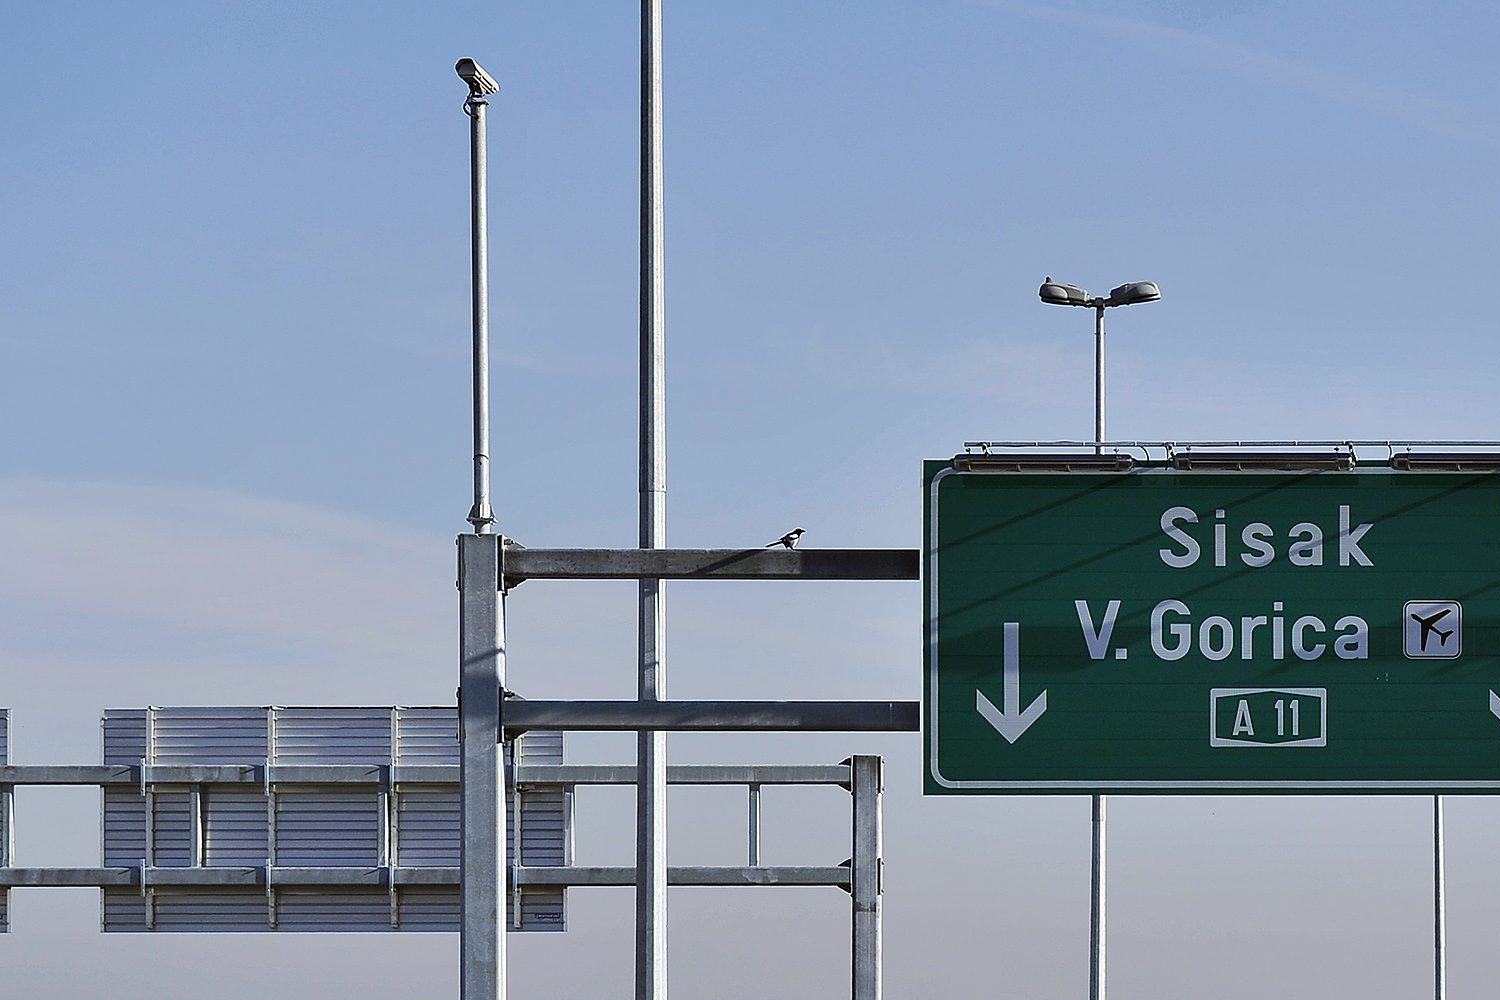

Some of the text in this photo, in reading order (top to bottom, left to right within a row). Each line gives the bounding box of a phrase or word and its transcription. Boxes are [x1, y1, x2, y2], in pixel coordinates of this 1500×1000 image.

[1158, 505, 1375, 568] Sisak
[1074, 599, 1369, 661] V. Gorica
[1231, 698, 1300, 737] A 11
